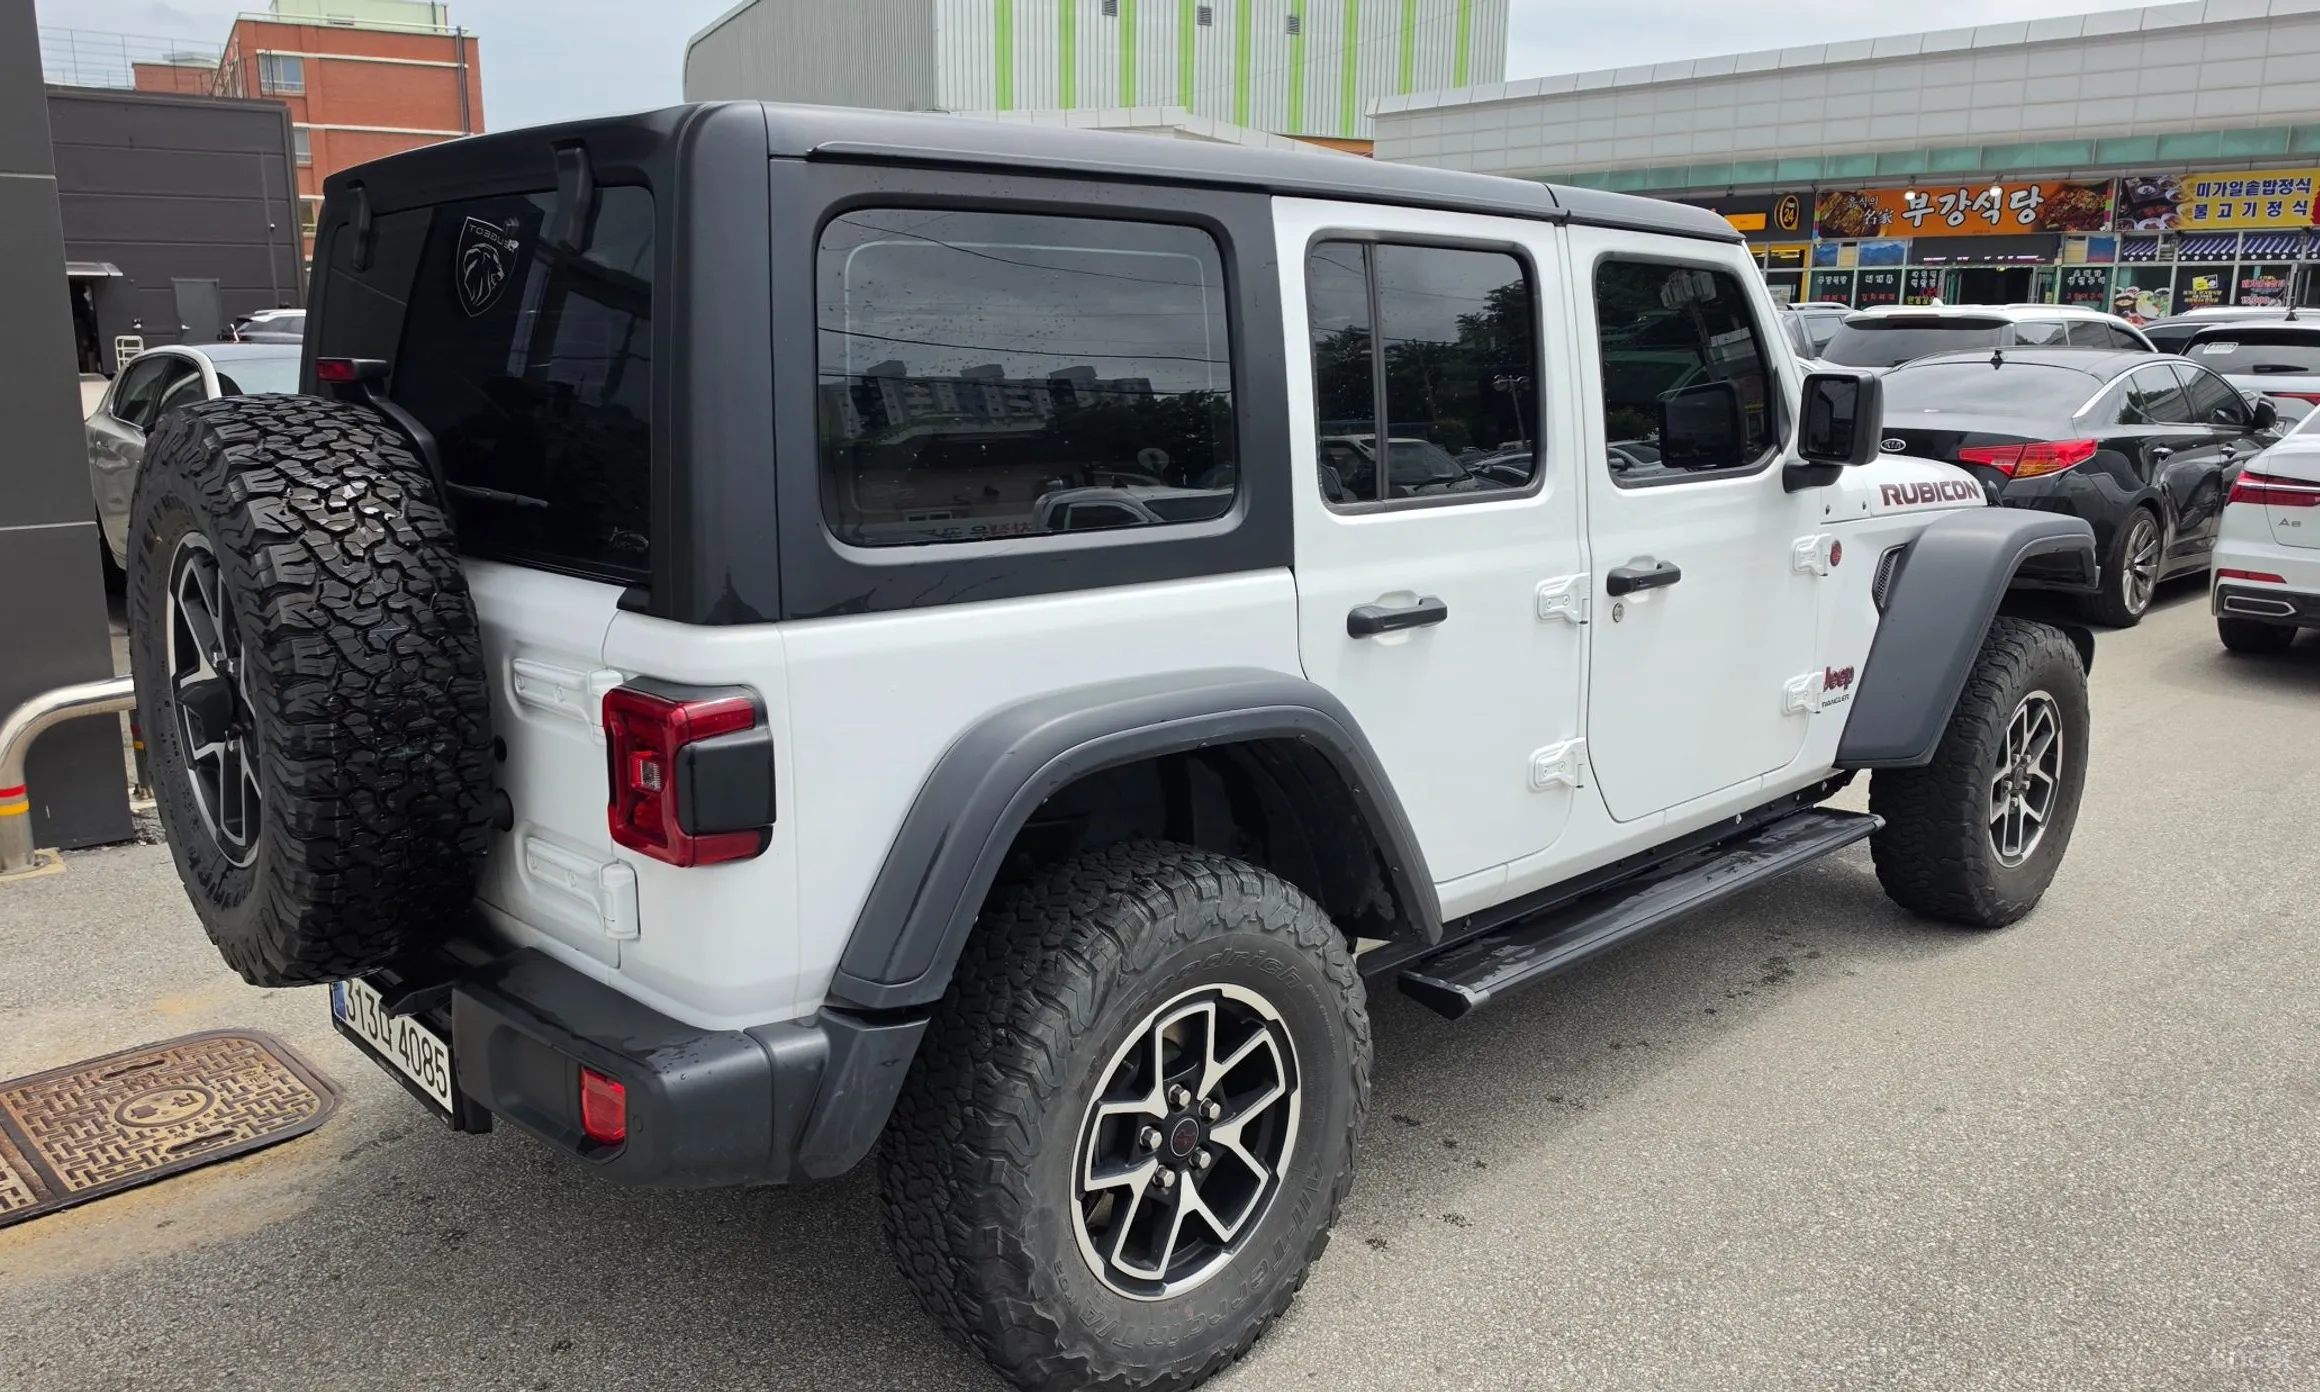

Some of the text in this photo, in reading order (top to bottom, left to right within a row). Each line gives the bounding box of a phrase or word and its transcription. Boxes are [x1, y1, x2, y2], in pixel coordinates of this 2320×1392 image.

[1783, 208, 1795, 224] 24
[1902, 184, 2044, 228] 부강식당
[1884, 440, 1902, 450] KIA
[1879, 480, 1981, 507] RUBICON
[1822, 665, 1855, 693] Jeep
[398, 1018, 448, 1099] 4085
